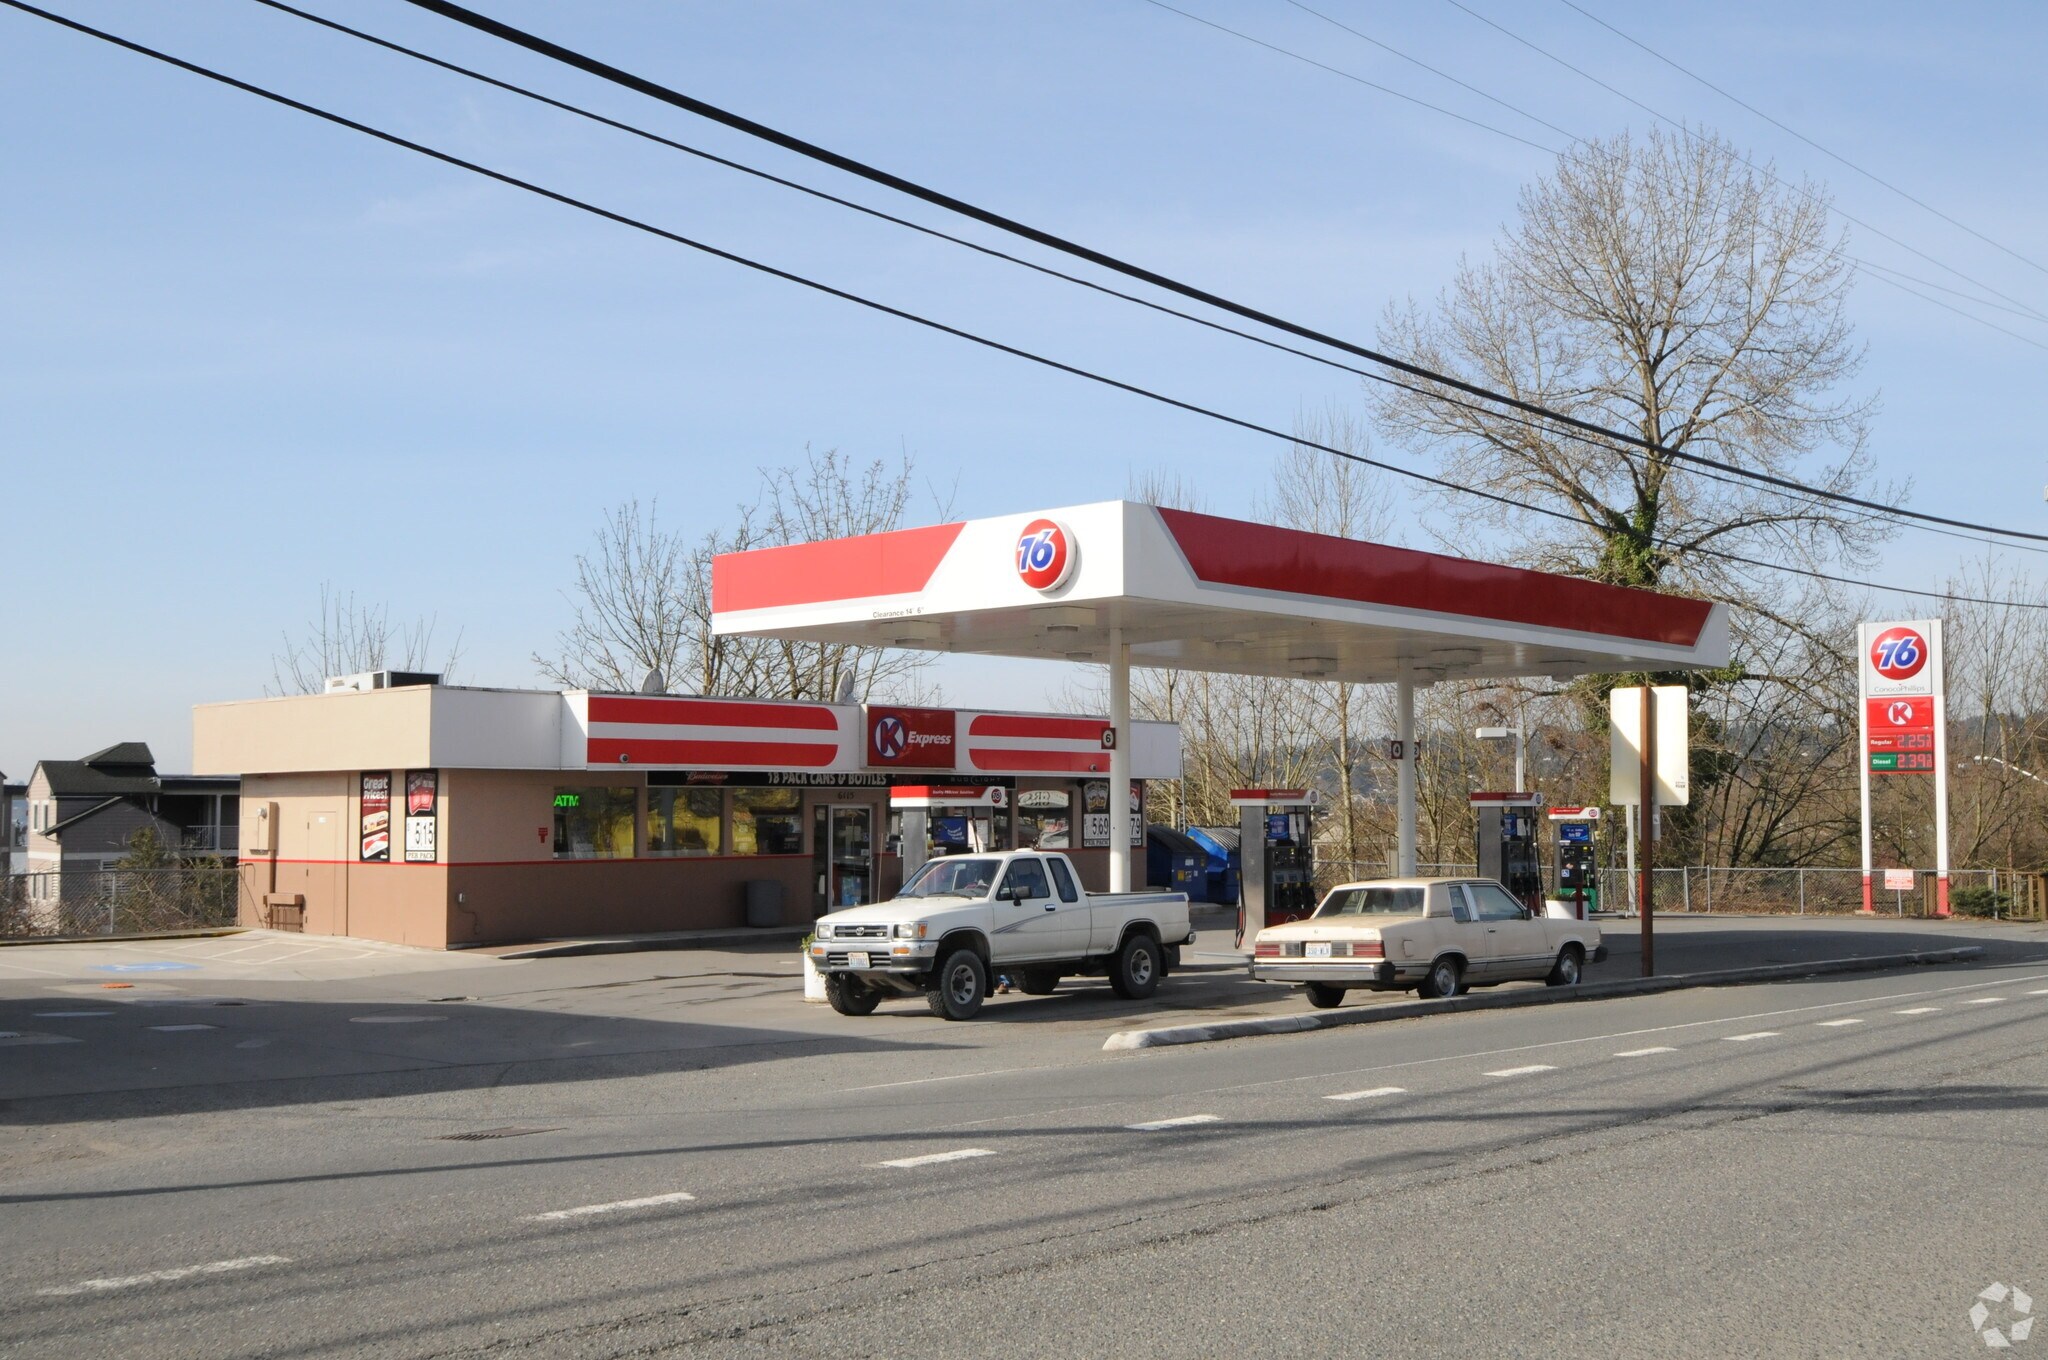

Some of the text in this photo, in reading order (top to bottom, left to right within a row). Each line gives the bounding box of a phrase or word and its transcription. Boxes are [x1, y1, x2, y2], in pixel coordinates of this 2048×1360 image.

[1017, 528, 1057, 573] 76
[872, 609, 904, 619] Clearance
[1876, 635, 1919, 671] 76
[1873, 684, 1926, 693] ConocoPhillips
[1891, 702, 1913, 725] K
[879, 718, 952, 755] K Express
[1105, 733, 1111, 743] 6
[1870, 739, 1893, 747] Regular
[363, 777, 389, 790] Great
[768, 772, 780, 784] 18
[782, 772, 808, 784] PACK
[810, 773, 836, 785] CANS
[848, 774, 887, 786] BOTTLES
[363, 789, 388, 800] Prices!
[838, 791, 855, 800] 6115
[553, 795, 579, 807] ATM
[420, 852, 434, 860] PACK
